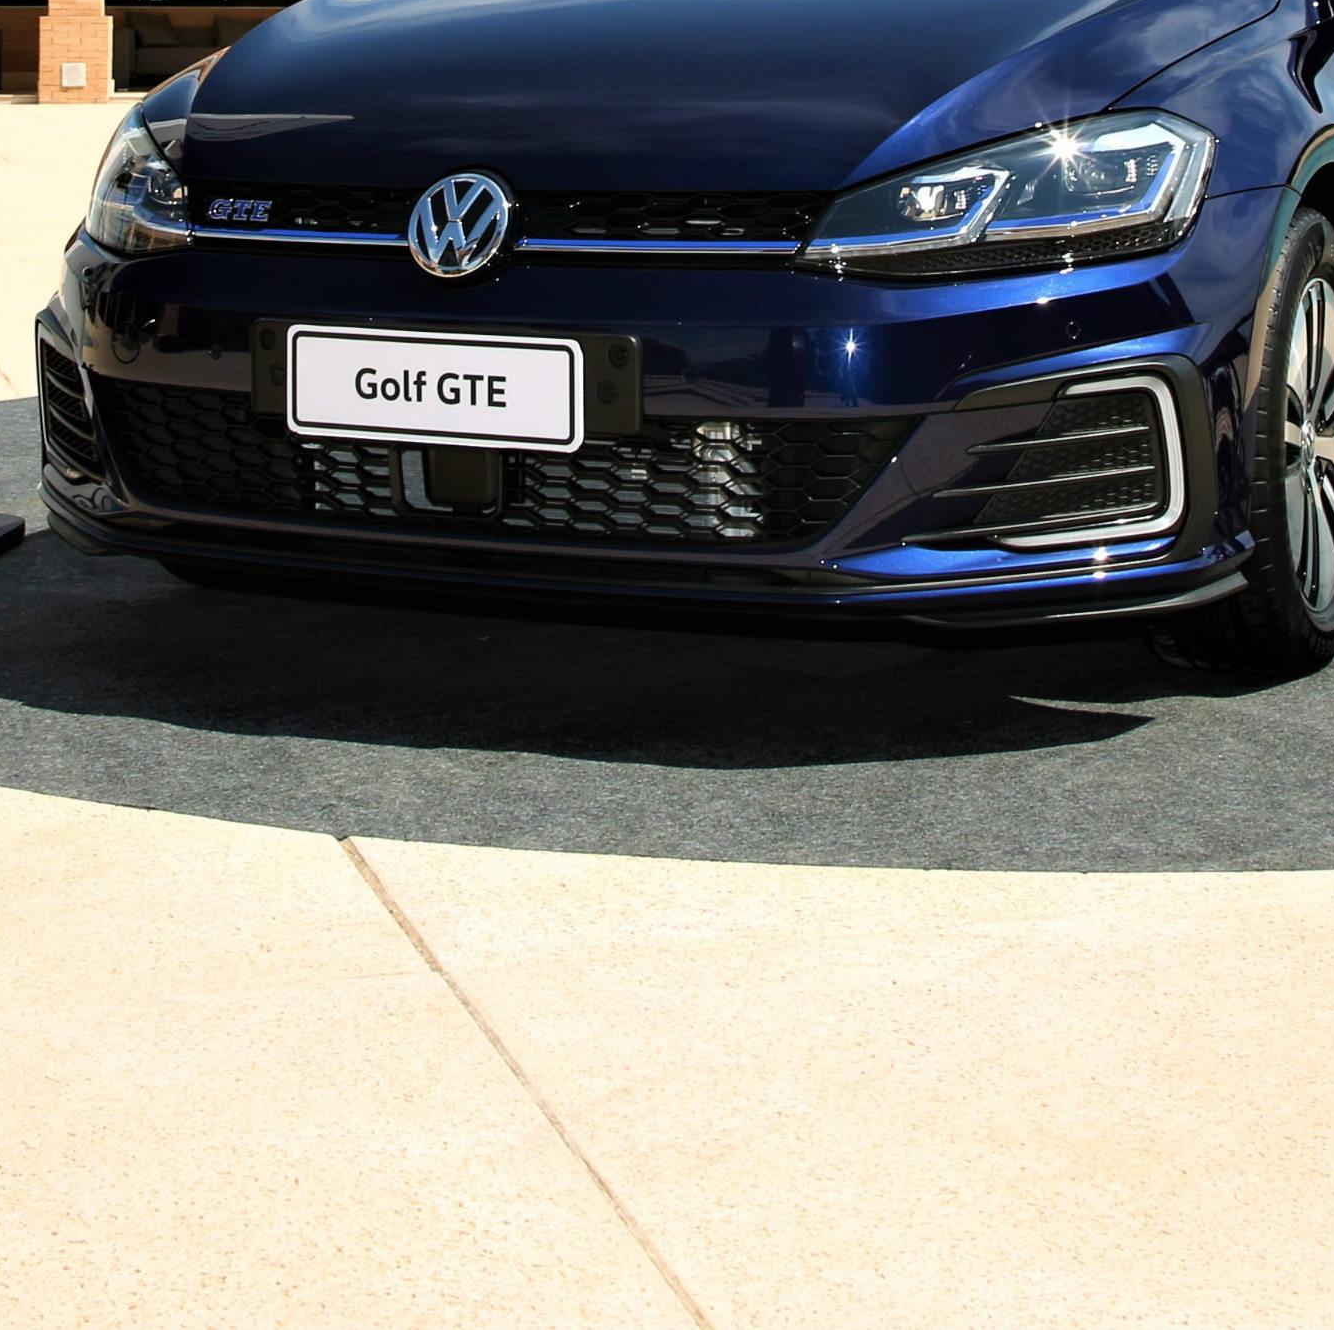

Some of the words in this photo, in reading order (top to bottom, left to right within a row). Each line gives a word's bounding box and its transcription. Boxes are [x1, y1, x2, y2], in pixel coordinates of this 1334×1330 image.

[209, 198, 273, 222] GTE
[355, 367, 428, 403] Golf
[436, 372, 508, 408] GTE
